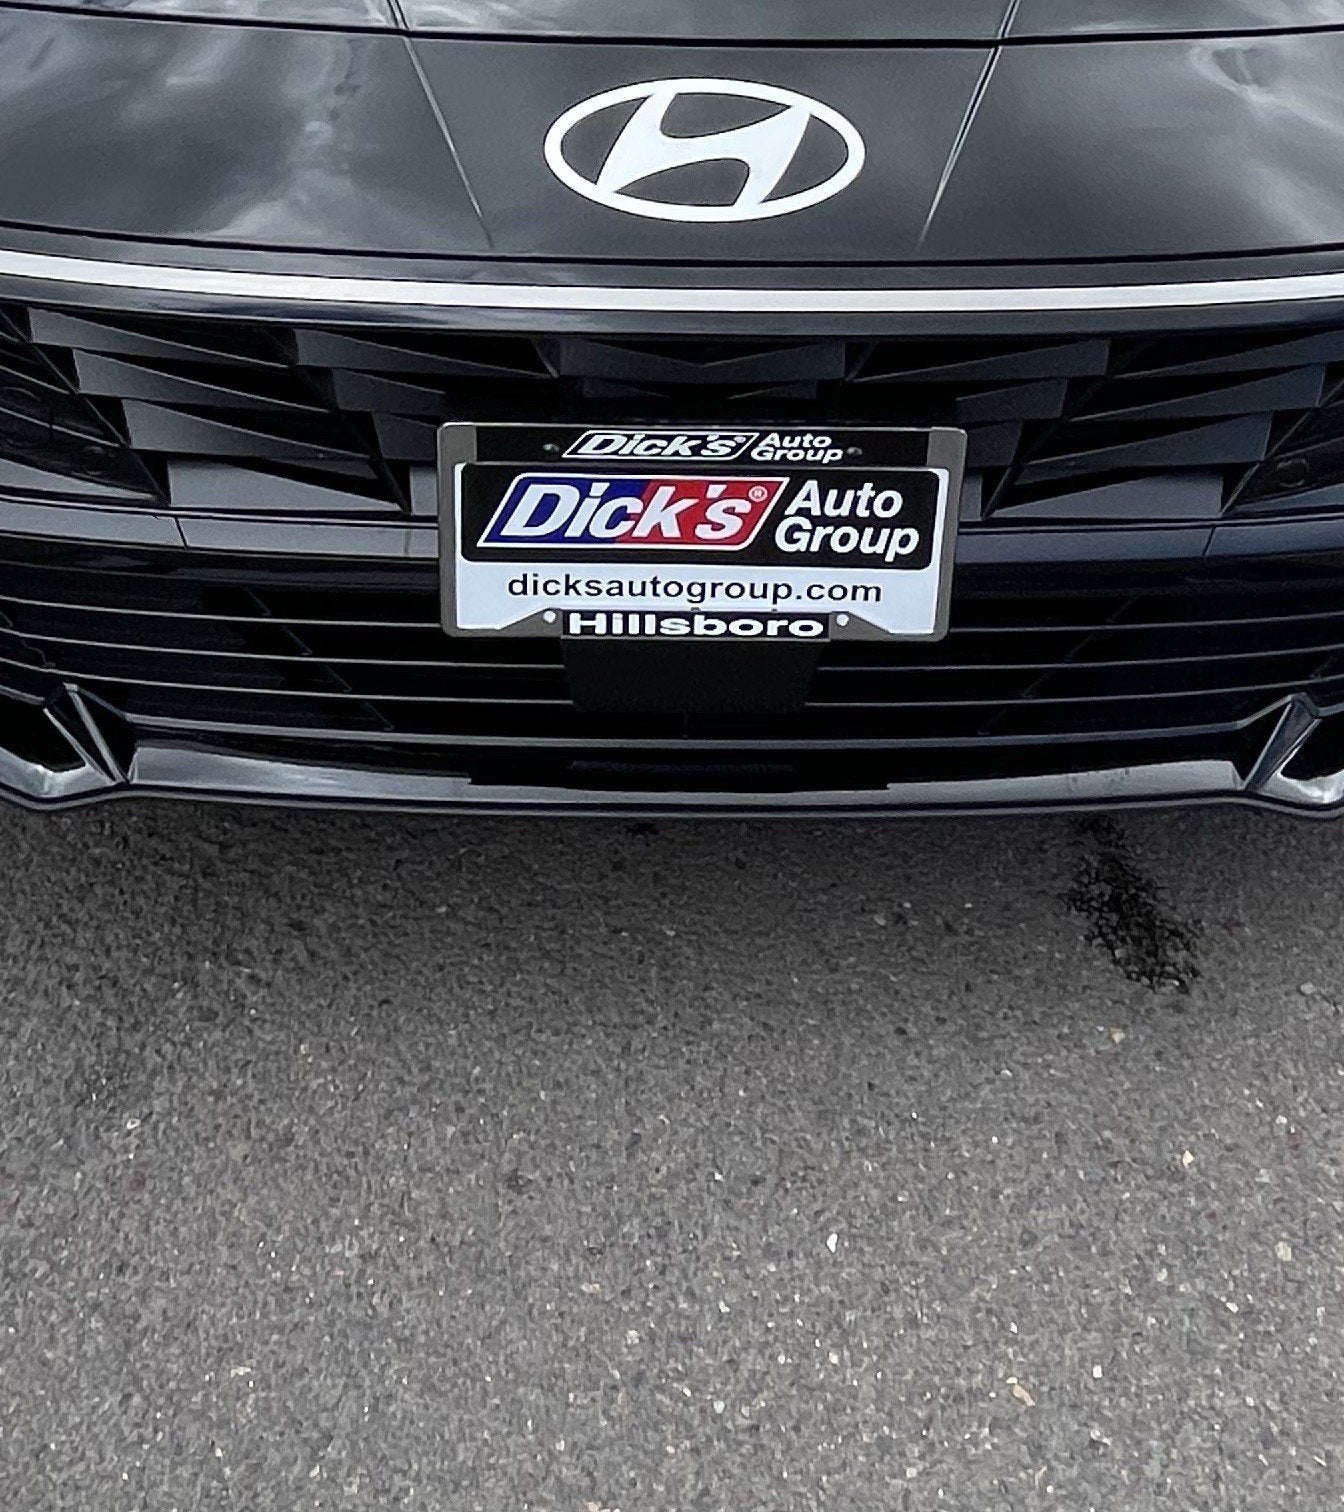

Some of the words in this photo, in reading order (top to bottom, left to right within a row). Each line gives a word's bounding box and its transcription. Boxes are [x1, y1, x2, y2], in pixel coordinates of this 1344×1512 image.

[575, 432, 737, 457] Dick's
[758, 432, 832, 448] Auto
[750, 445, 844, 464] Group
[499, 481, 753, 540] Dick's
[784, 479, 903, 519] Auto
[774, 516, 920, 563] Group
[507, 572, 882, 604] dicksautogroup.com
[568, 612, 824, 637] Hillsboro
